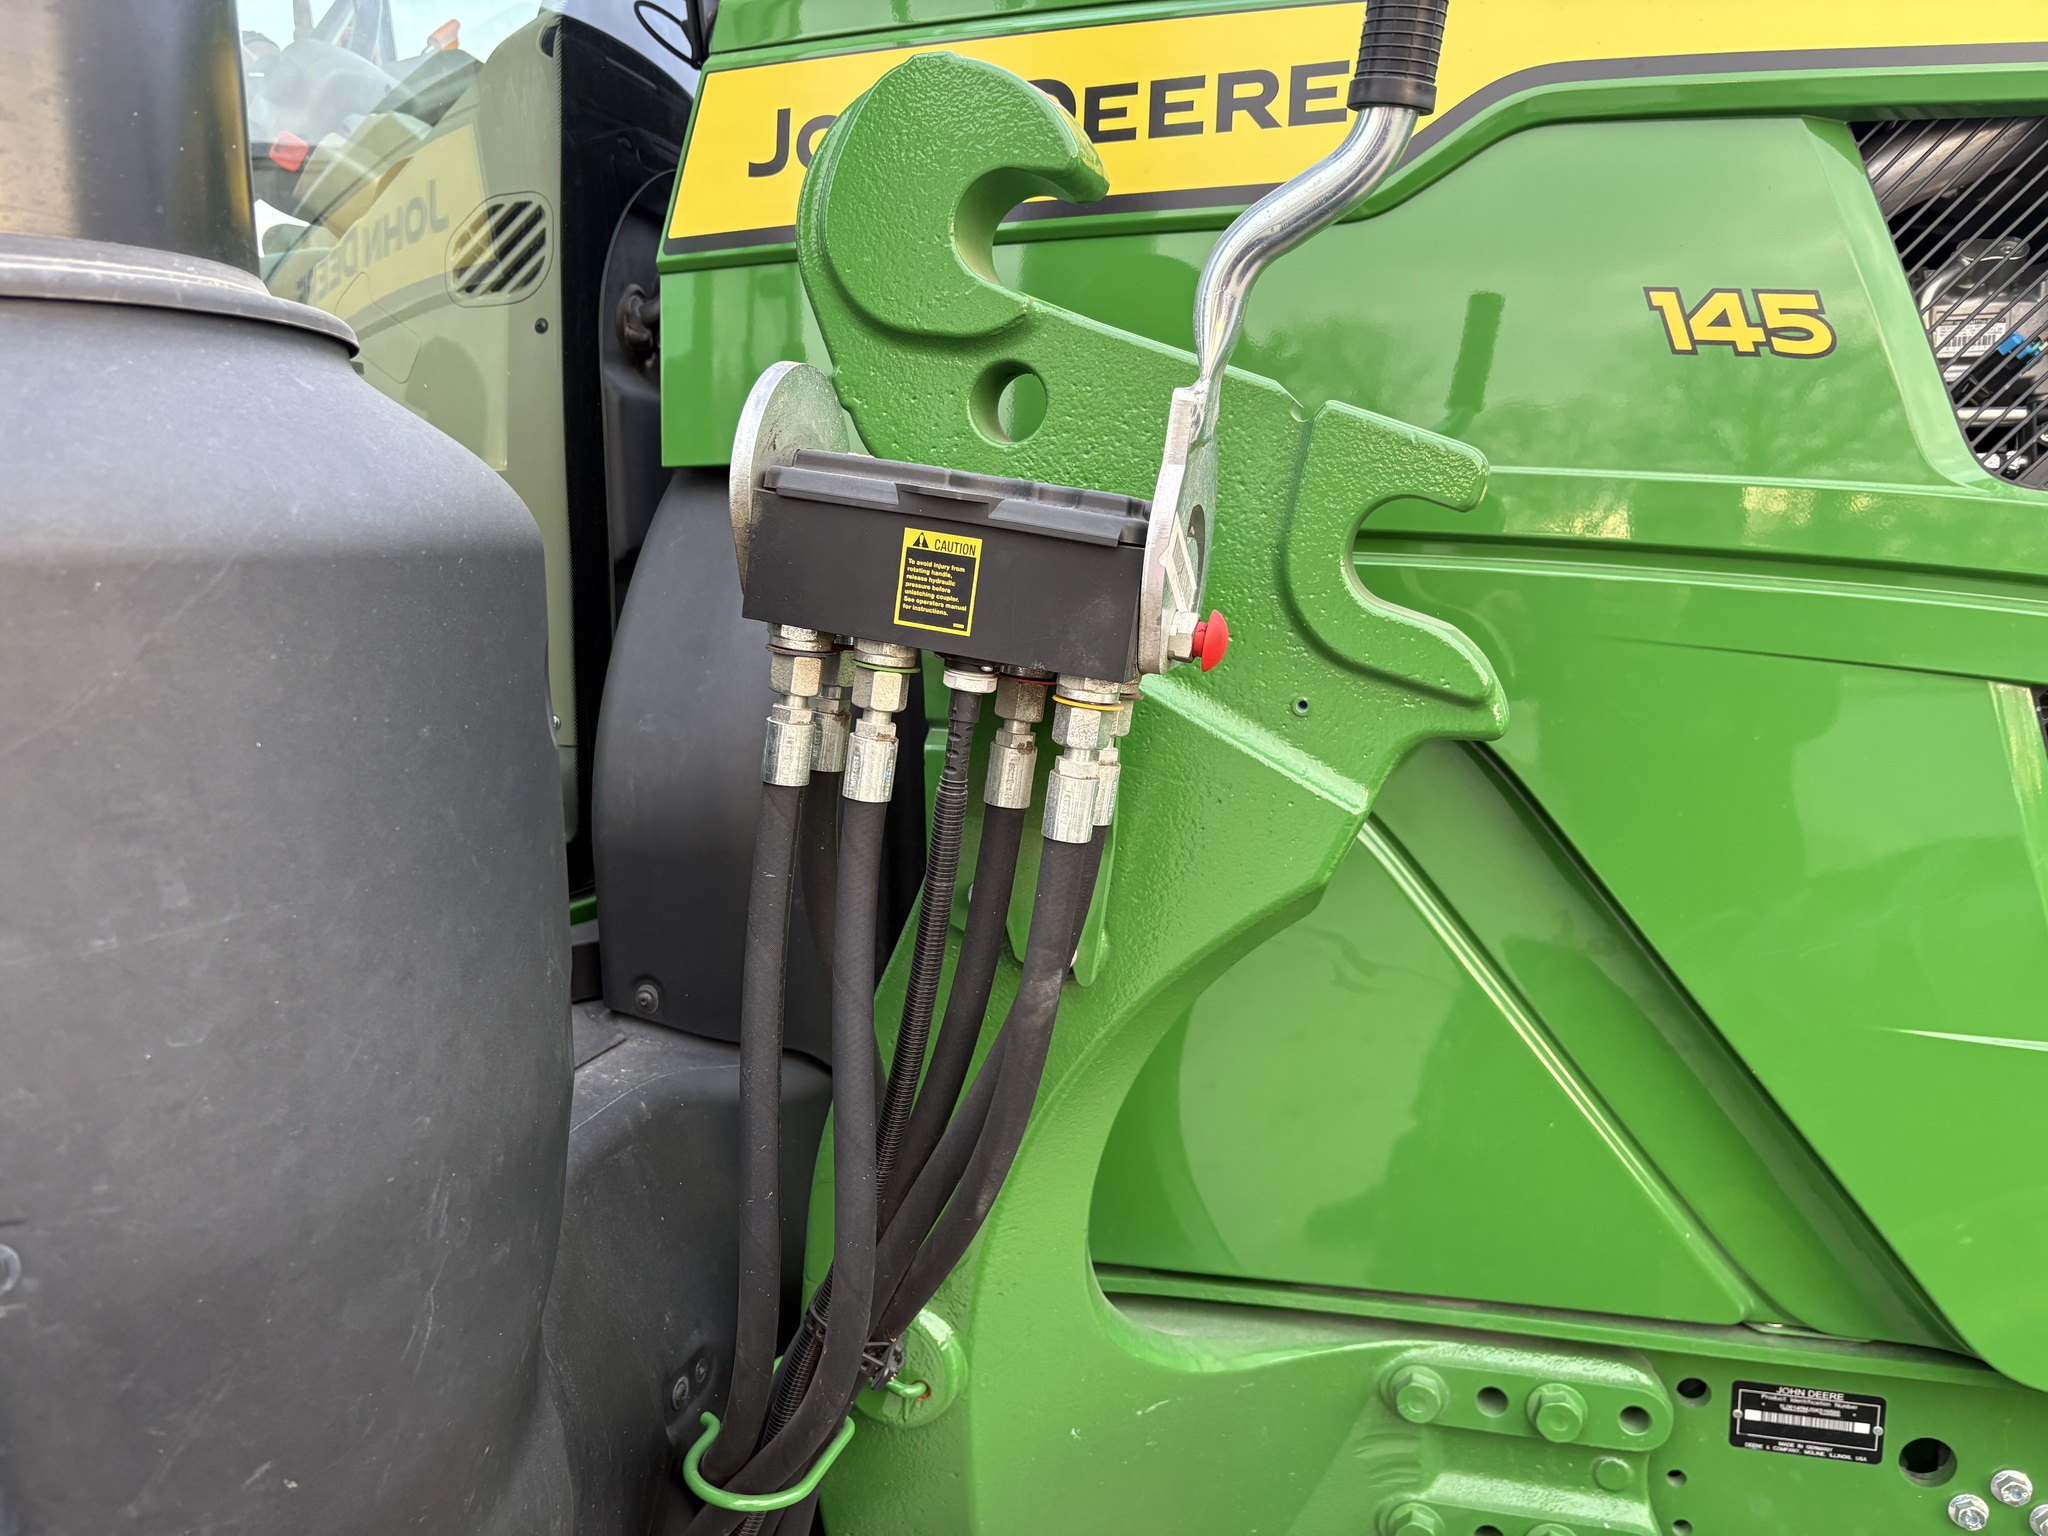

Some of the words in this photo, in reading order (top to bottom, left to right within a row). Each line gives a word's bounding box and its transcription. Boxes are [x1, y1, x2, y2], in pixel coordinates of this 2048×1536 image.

[1643, 286, 1837, 359] 145
[934, 539, 976, 556] CAUTION
[907, 566, 930, 575] rotating
[934, 562, 950, 571] injury
[906, 574, 927, 582] release
[929, 577, 955, 586] hydraulic
[905, 583, 930, 591] pressure
[932, 585, 951, 593] before
[904, 589, 934, 599] unlatching
[912, 605, 948, 616] instructions.
[945, 602, 967, 611] manual
[1776, 1387, 1806, 1397] JOHN
[1807, 1389, 1845, 1401] DEERE
[1761, 1394, 1786, 1402] Product
[1790, 1397, 1831, 1407] Identification
[1834, 1402, 1858, 1410] Number
[1806, 1444, 1833, 1452] GERMANY
